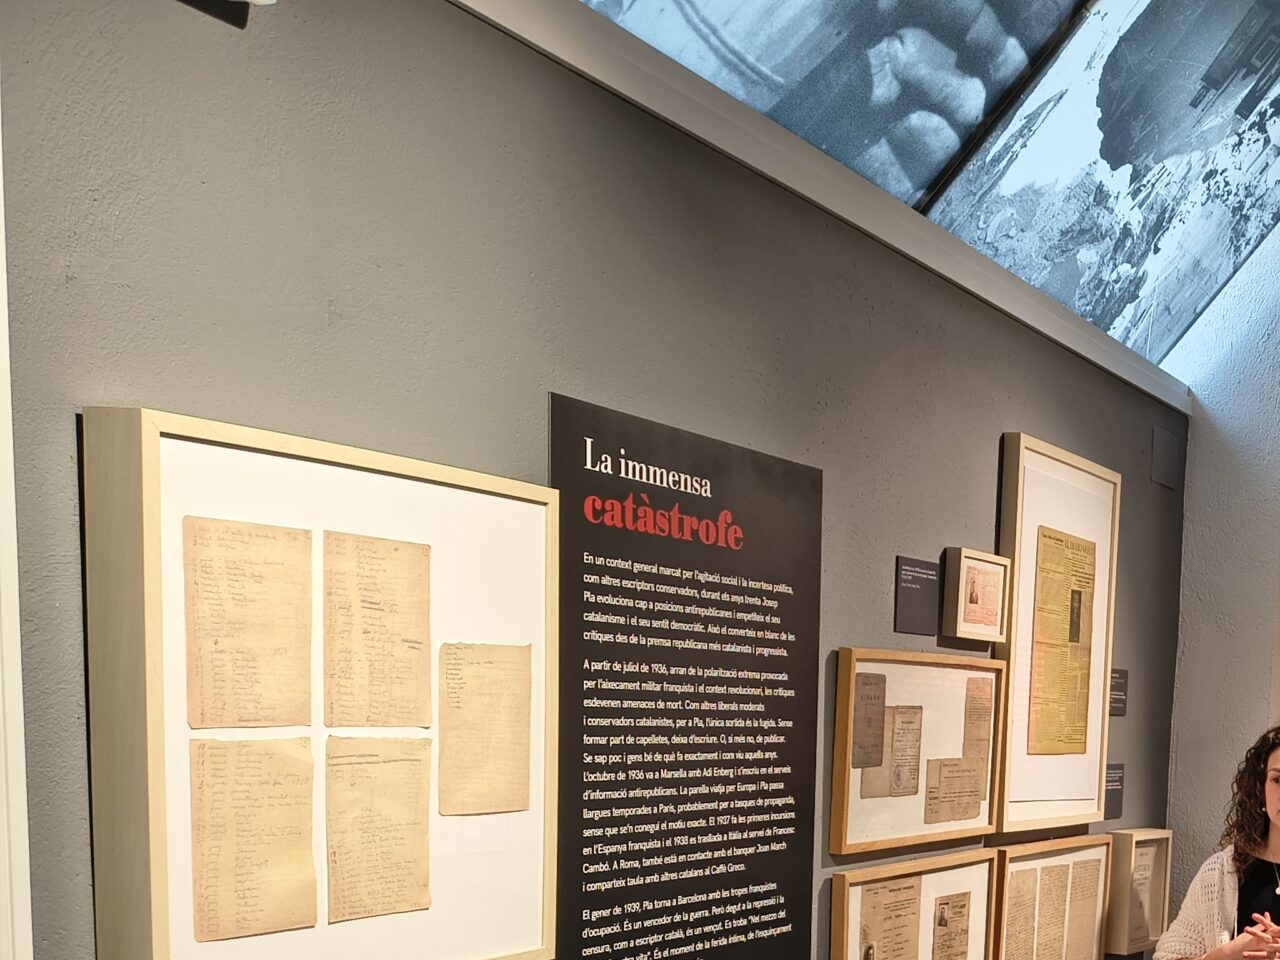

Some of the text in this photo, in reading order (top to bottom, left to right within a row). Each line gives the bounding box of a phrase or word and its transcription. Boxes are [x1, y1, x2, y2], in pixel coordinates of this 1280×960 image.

[584, 437, 712, 497] La immensa
[583, 492, 743, 550] catàstrofe
[584, 552, 681, 577] En un context general marcat
[583, 574, 655, 592] com altres escriptors
[584, 591, 648, 611] Pla evoluciona cap
[583, 611, 669, 629] catalanisme i el seu sentit
[583, 630, 671, 647] crítiques des de la premsa
[583, 659, 669, 675] A partir de juliol de 1936,
[583, 678, 662, 691] per l'aixecament militar
[583, 697, 665, 709] esdevenen amenaces de
[583, 715, 675, 728] i conservadors catalanistes,
[583, 734, 608, 744] formar
[609, 735, 625, 747] part
[625, 734, 635, 744] de
[583, 751, 676, 765] Se sap poc i gens bé de què
[583, 771, 615, 782] L'octubre
[617, 770, 626, 780] de
[628, 770, 644, 780] 1936
[583, 788, 627, 800] d'informació
[583, 803, 676, 821] llargues temporades a París,
[583, 828, 603, 837] sense
[605, 827, 618, 837] que
[619, 823, 633, 834] se'n
[661, 820, 667, 830] el
[583, 837, 672, 855] en l'Espanya franquista i el
[582, 853, 677, 874] Cambó. A Roma, també està
[583, 872, 678, 892] i comparteix taula amb altres
[583, 899, 671, 921] El gener de 1939, Pla torna
[582, 912, 682, 938] d'ocupació. És un vencedor de
[582, 944, 612, 956] censura,
[613, 941, 628, 950] com
[635, 933, 664, 946] escriptor
[654, 947, 662, 959] És
[663, 948, 669, 957] el
